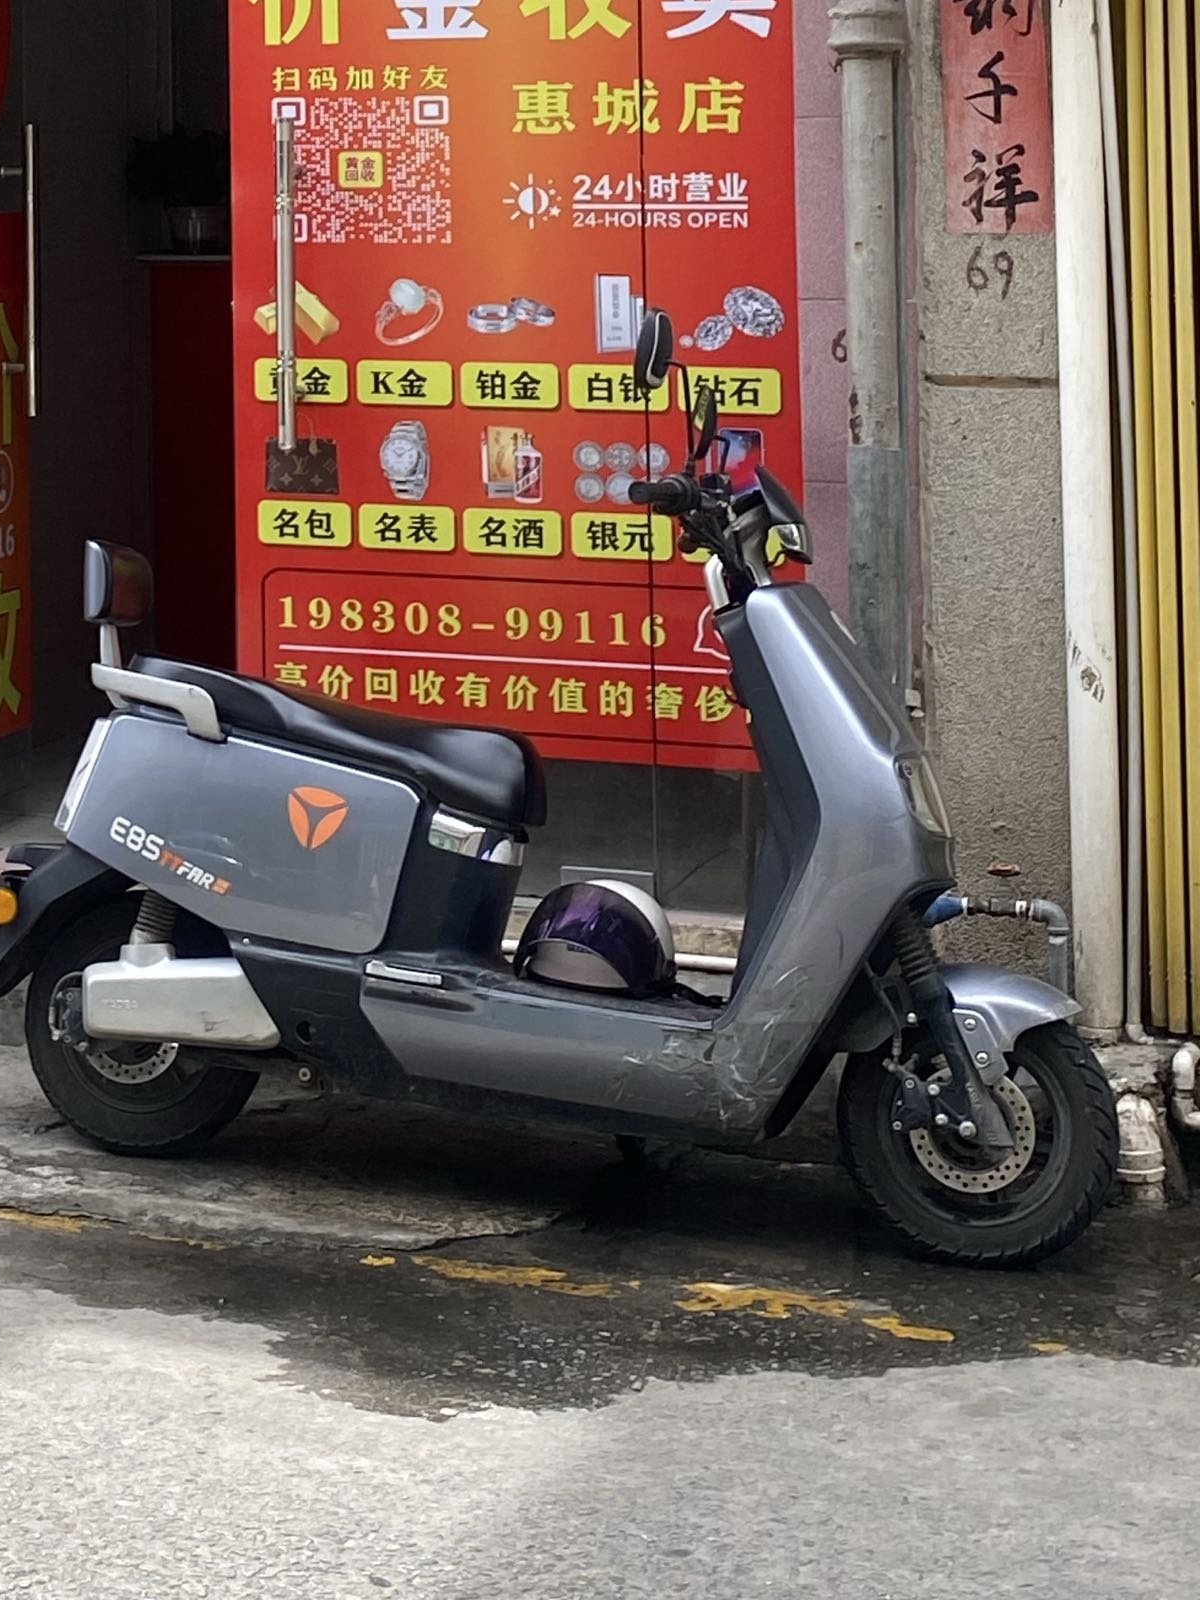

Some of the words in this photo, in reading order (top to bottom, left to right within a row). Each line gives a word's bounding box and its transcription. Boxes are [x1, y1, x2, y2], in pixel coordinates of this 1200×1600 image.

[272, 65, 449, 92] 扫码加好友
[512, 77, 745, 135] 惠城店
[573, 172, 749, 202] 24小时营业
[573, 211, 681, 229] 24-HOURS
[687, 211, 749, 229] OPEN
[966, 246, 1015, 301] 69
[370, 368, 428, 398] K金
[476, 370, 542, 401] 铂金
[273, 508, 336, 540] 名包
[374, 512, 439, 544] 名表
[480, 517, 545, 549] 名酒
[586, 520, 655, 552] 银元
[279, 595, 667, 648] 198308-99116
[274, 661, 753, 723] 高价回收有价值的奢侈
